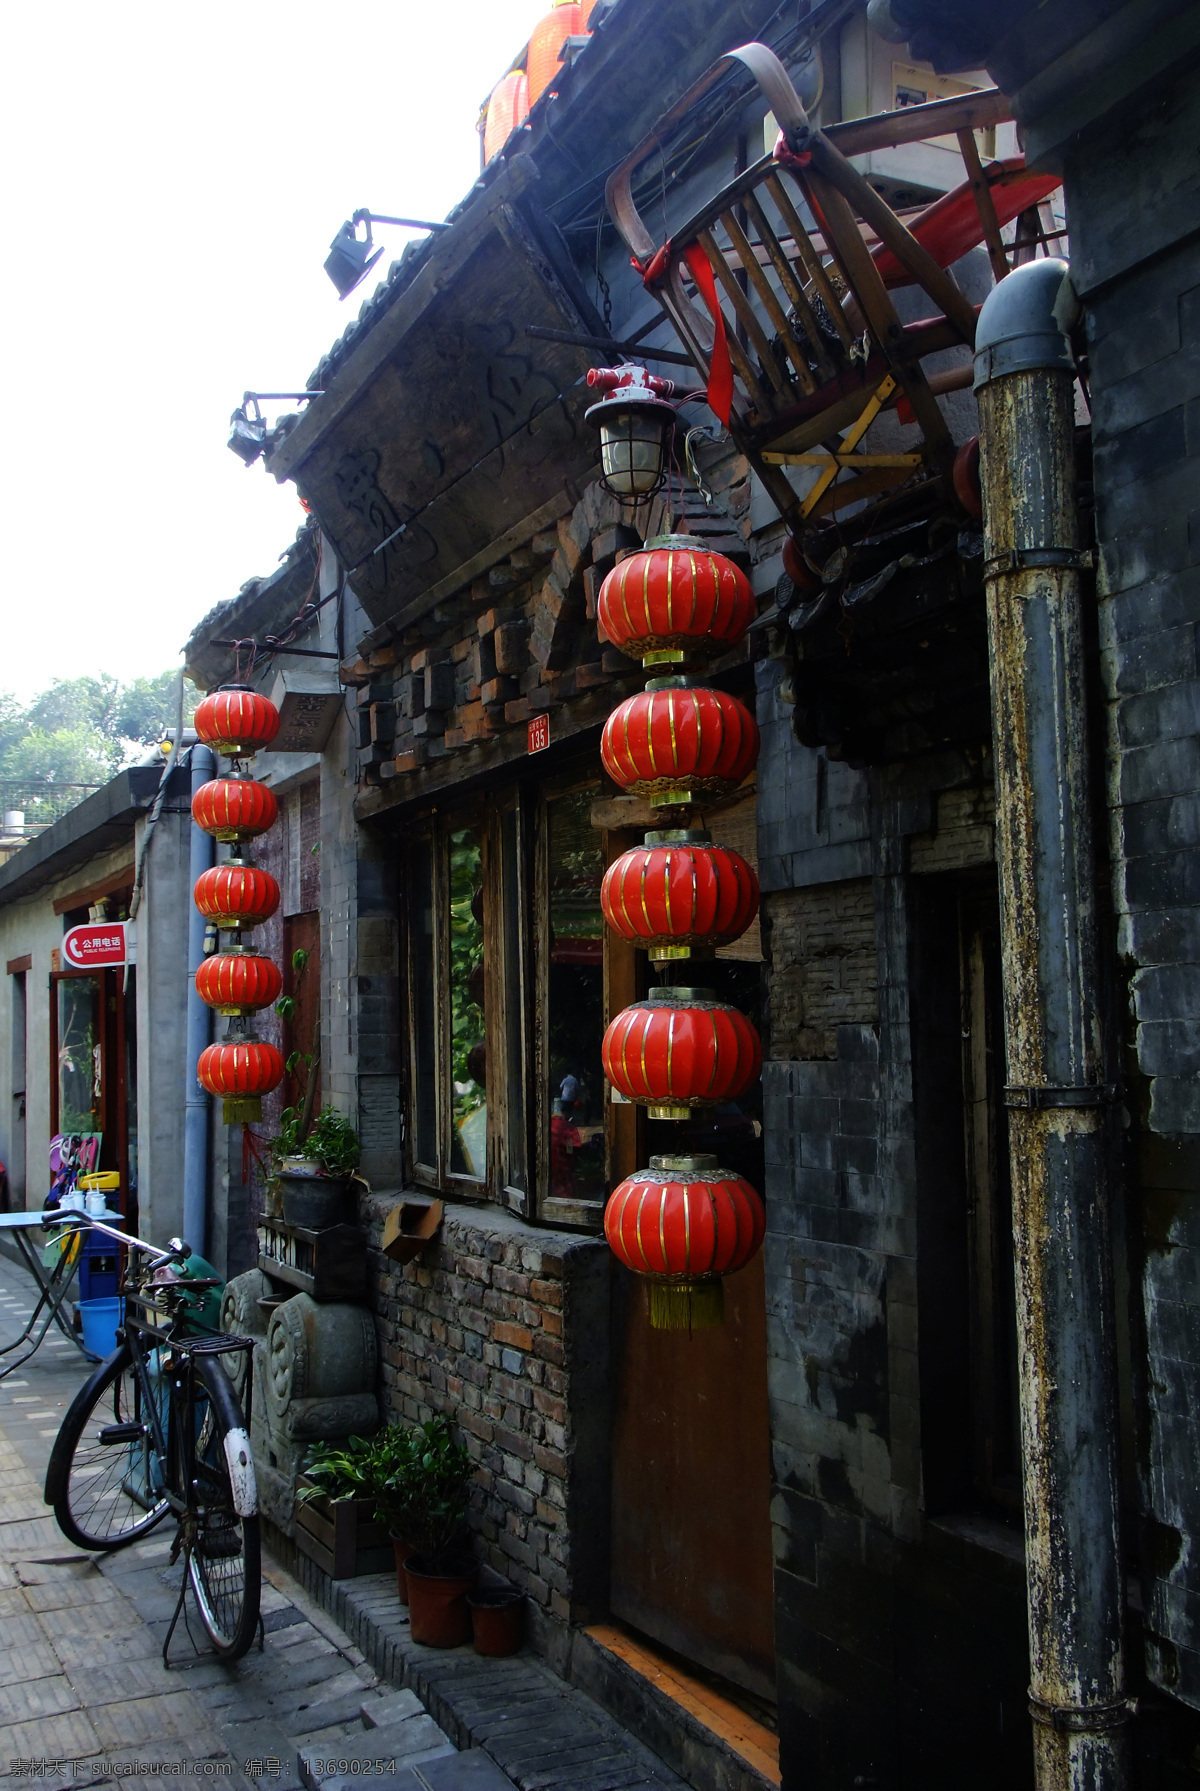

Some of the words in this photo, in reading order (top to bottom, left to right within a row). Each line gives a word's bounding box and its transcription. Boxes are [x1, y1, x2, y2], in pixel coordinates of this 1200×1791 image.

[531, 728, 545, 750] 135
[82, 936, 121, 948] 公用电话
